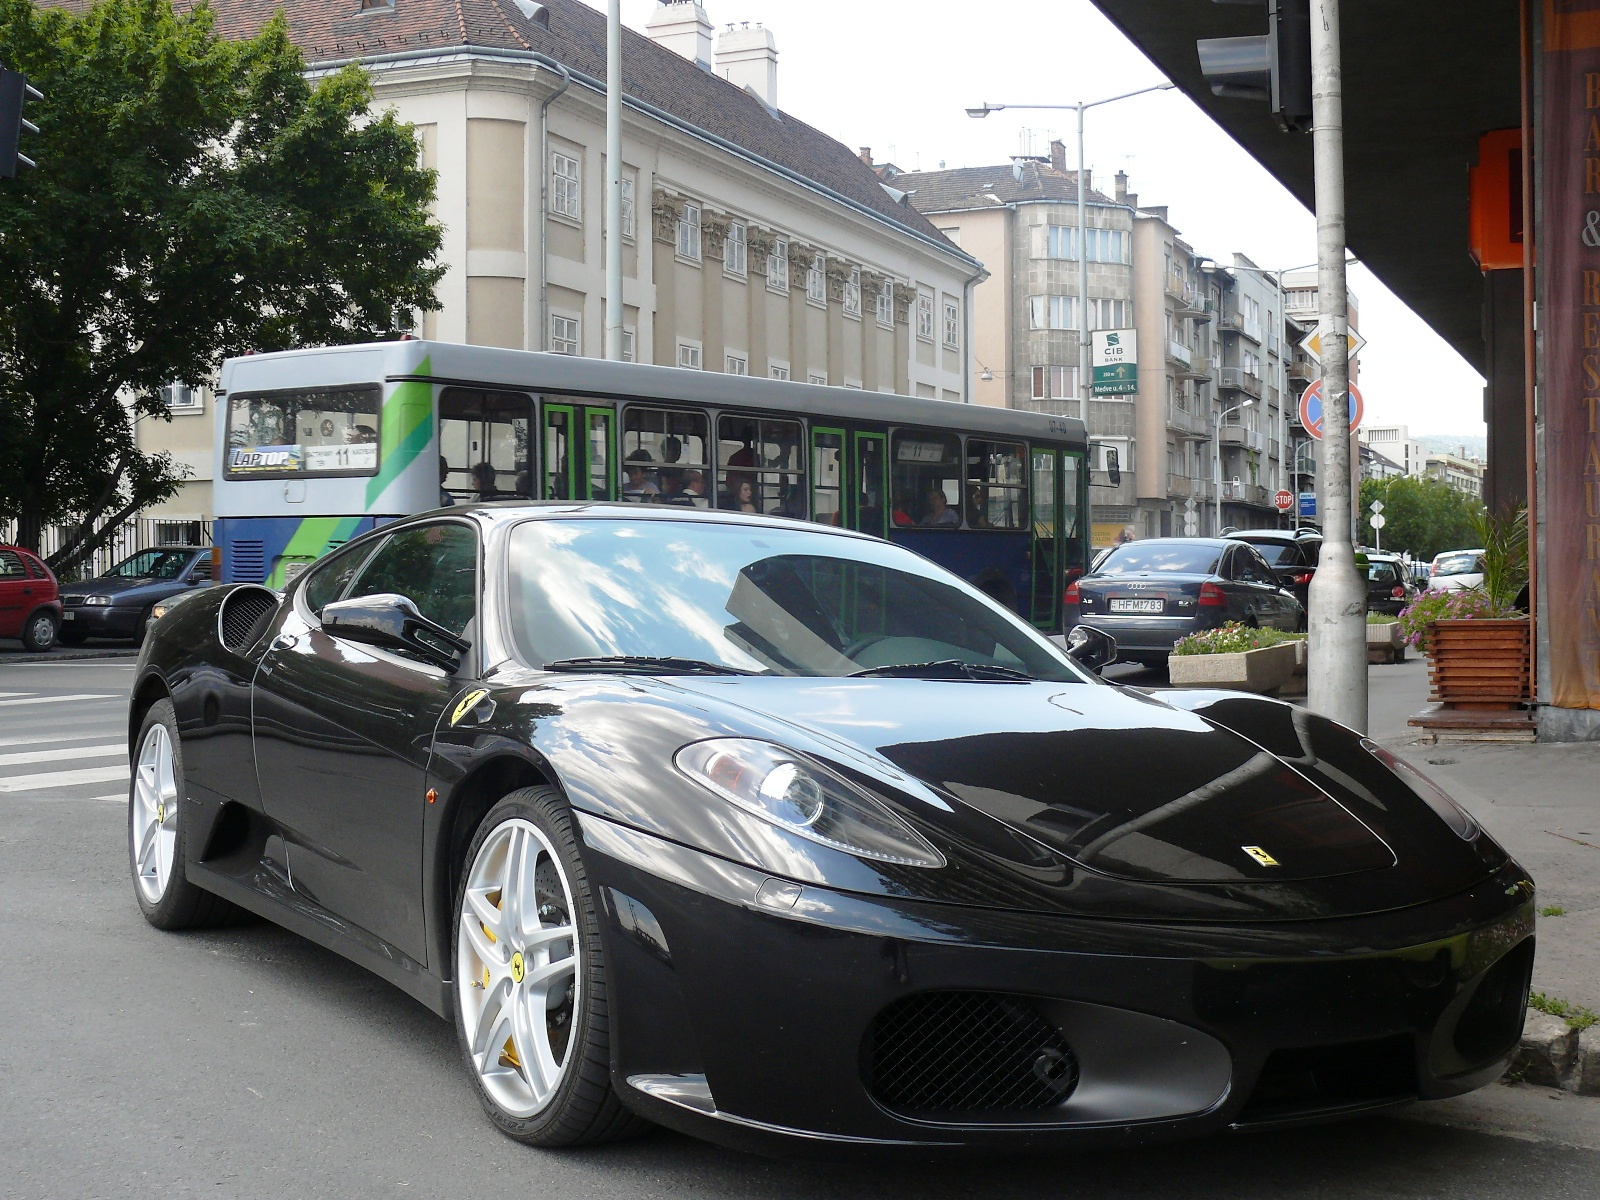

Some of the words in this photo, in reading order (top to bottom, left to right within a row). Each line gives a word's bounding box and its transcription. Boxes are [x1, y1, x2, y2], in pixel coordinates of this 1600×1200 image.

[1583, 72, 1600, 194] BAR
[1581, 210, 1600, 247] &
[1104, 347, 1124, 355] CIB
[234, 450, 290, 466] LAPTOP
[335, 447, 349, 466] 11
[1582, 270, 1600, 686] RESTAURANT
[1275, 496, 1292, 504] STOP
